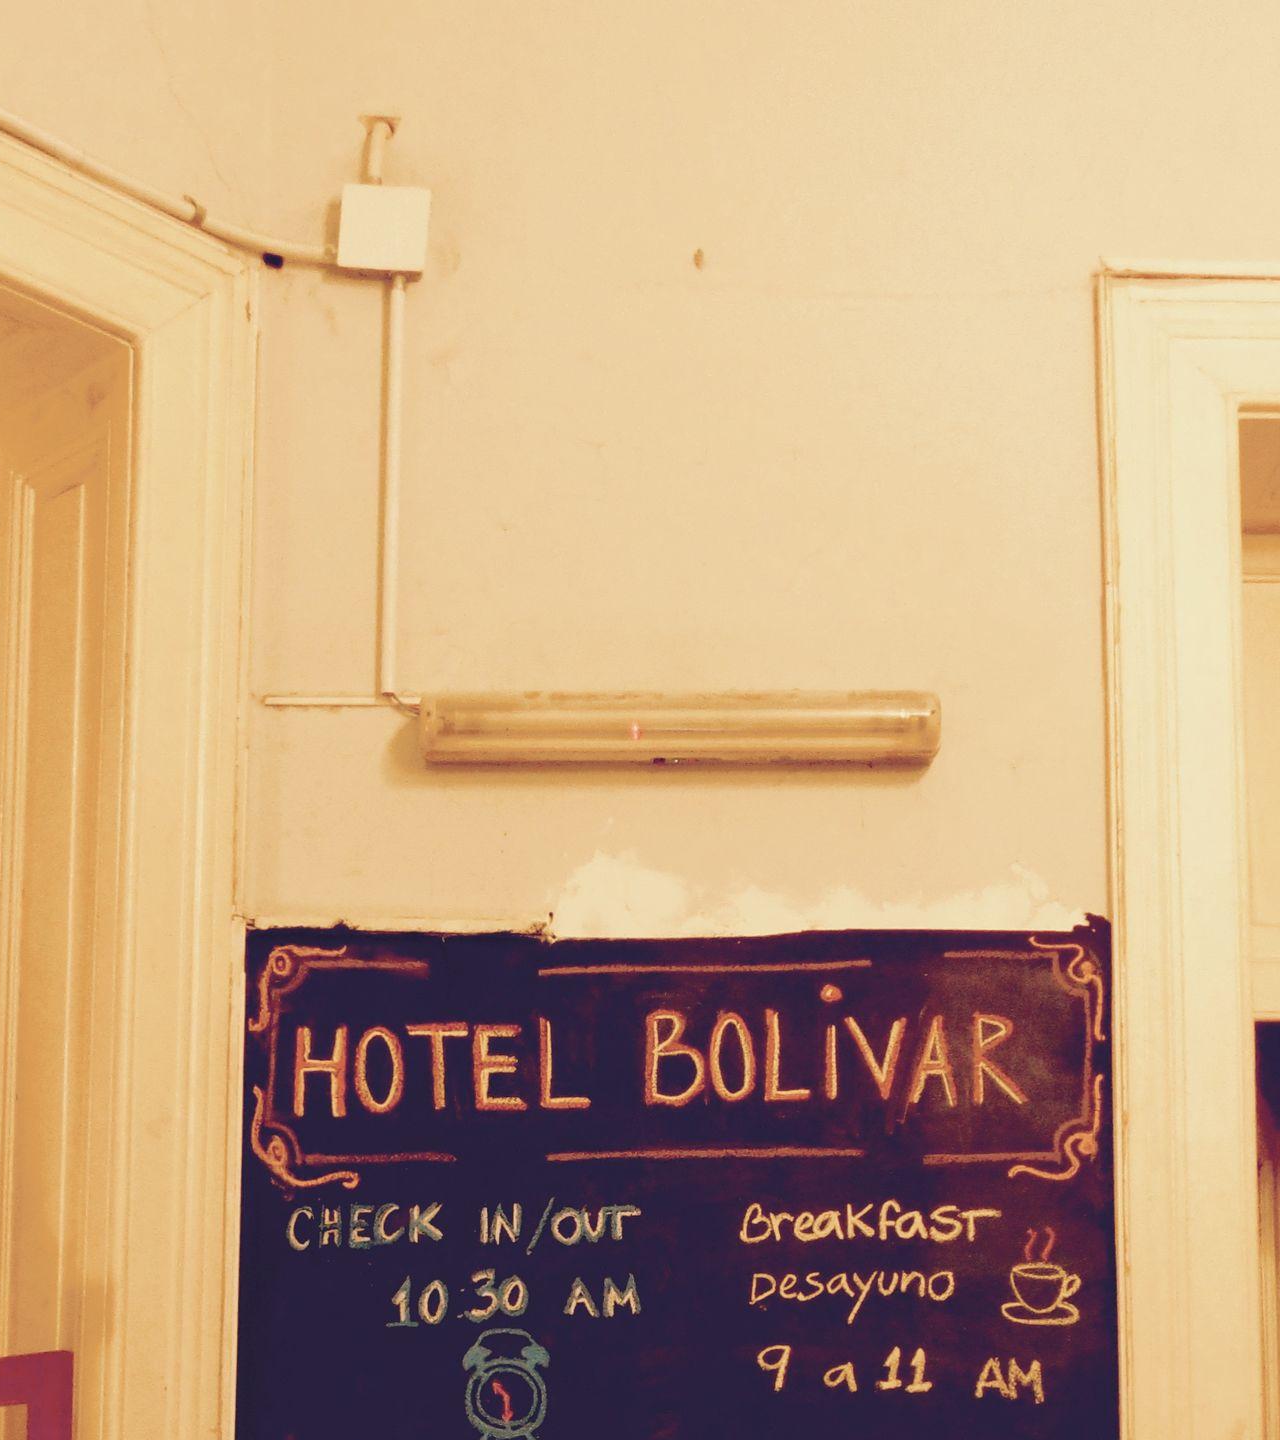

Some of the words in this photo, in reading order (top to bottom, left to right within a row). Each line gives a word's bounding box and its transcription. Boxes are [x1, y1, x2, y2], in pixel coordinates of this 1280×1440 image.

[294, 1016, 591, 1118] HOTEL
[286, 1201, 444, 1251] CHECK
[478, 1199, 642, 1256] IN/OUT
[385, 1269, 530, 1328] 10:30
[563, 1273, 643, 1319] AM
[749, 1269, 956, 1326] Desayuno
[757, 1344, 792, 1392] 9
[823, 1360, 859, 1394] a
[876, 1346, 934, 1394] 11
[974, 1357, 1045, 1405] AM
